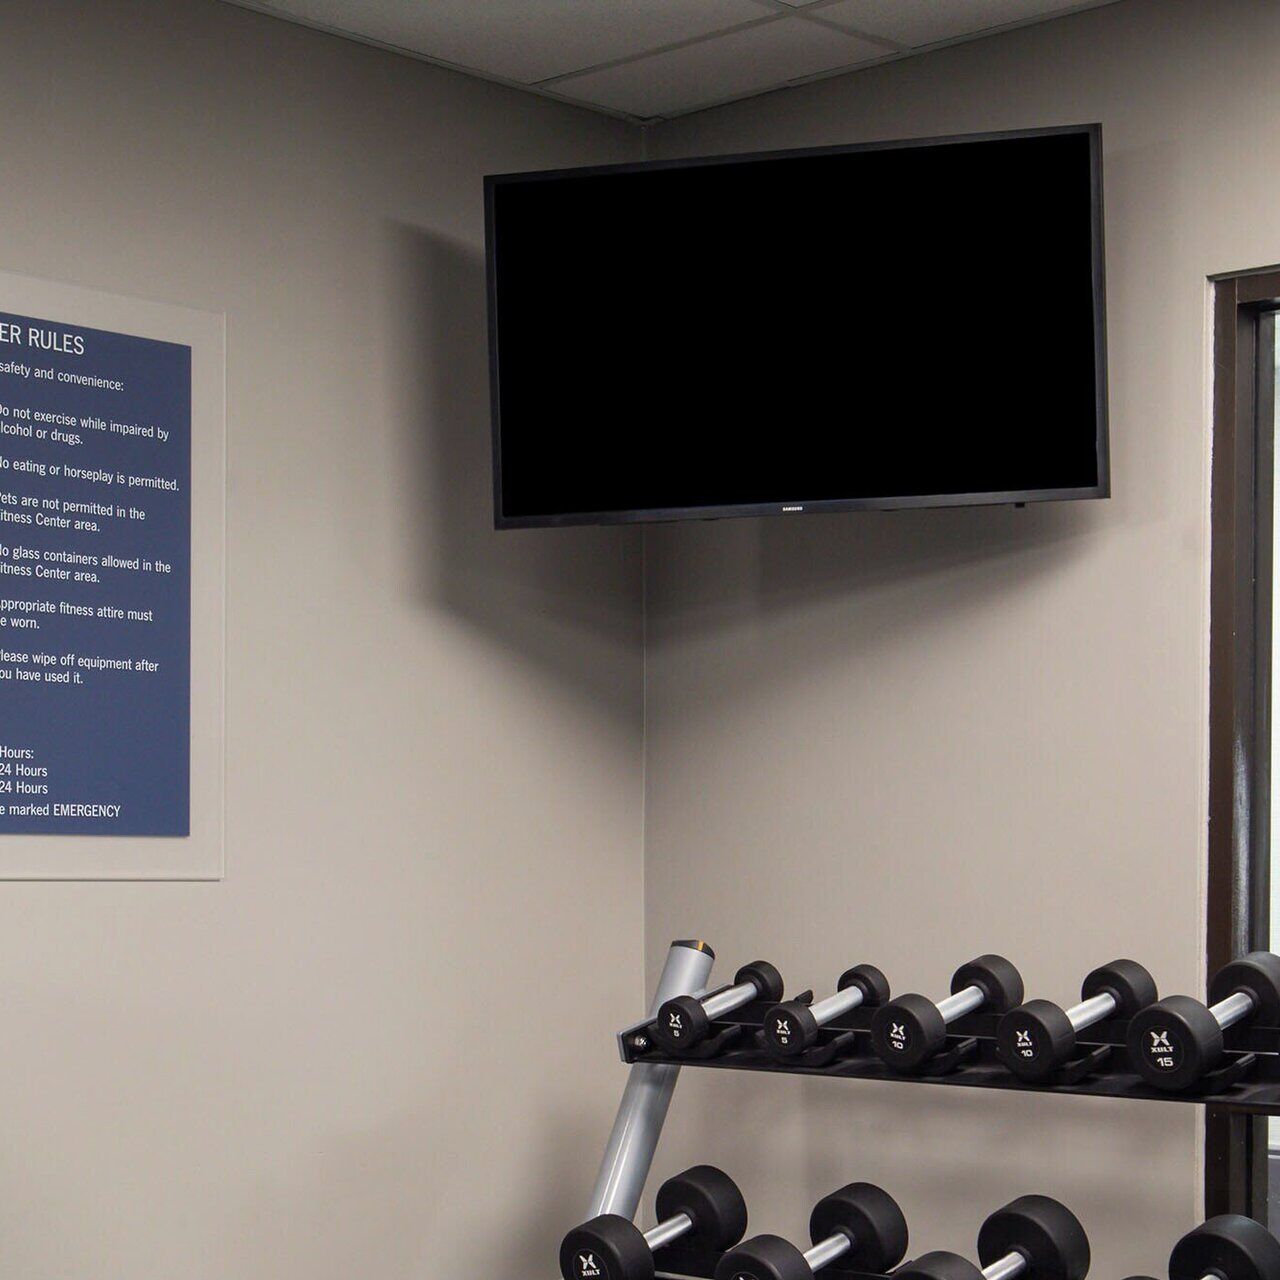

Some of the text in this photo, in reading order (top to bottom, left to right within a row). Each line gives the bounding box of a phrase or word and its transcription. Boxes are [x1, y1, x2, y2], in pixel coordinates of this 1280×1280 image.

[29, 328, 84, 355] RULES
[34, 368, 54, 379] and
[57, 372, 123, 391] convenience:
[13, 408, 30, 420] not
[34, 412, 77, 426] exercise
[80, 417, 106, 430] while
[110, 420, 153, 437] impaired
[157, 427, 169, 442] by
[36, 429, 47, 439] or
[51, 429, 83, 445] drugs.
[13, 460, 46, 476] eating
[49, 465, 60, 475] or
[64, 465, 113, 484] horseplay
[117, 472, 125, 484] is
[129, 476, 179, 491] permitted.
[21, 497, 39, 507] are
[42, 499, 59, 510] not
[63, 502, 113, 516] permitted
[117, 505, 125, 517] in
[129, 507, 145, 520] the
[59, 601, 94, 616] fitness
[97, 606, 124, 619] attire
[127, 610, 153, 621] must
[0, 745, 34, 759] Hours:
[16, 763, 48, 777] Hours
[9, 803, 49, 816] marked
[53, 804, 121, 817] EMERGENCY
[892, 1041, 903, 1049] 10
[1021, 1049, 1033, 1057] 10
[1157, 1057, 1173, 1066] 15
